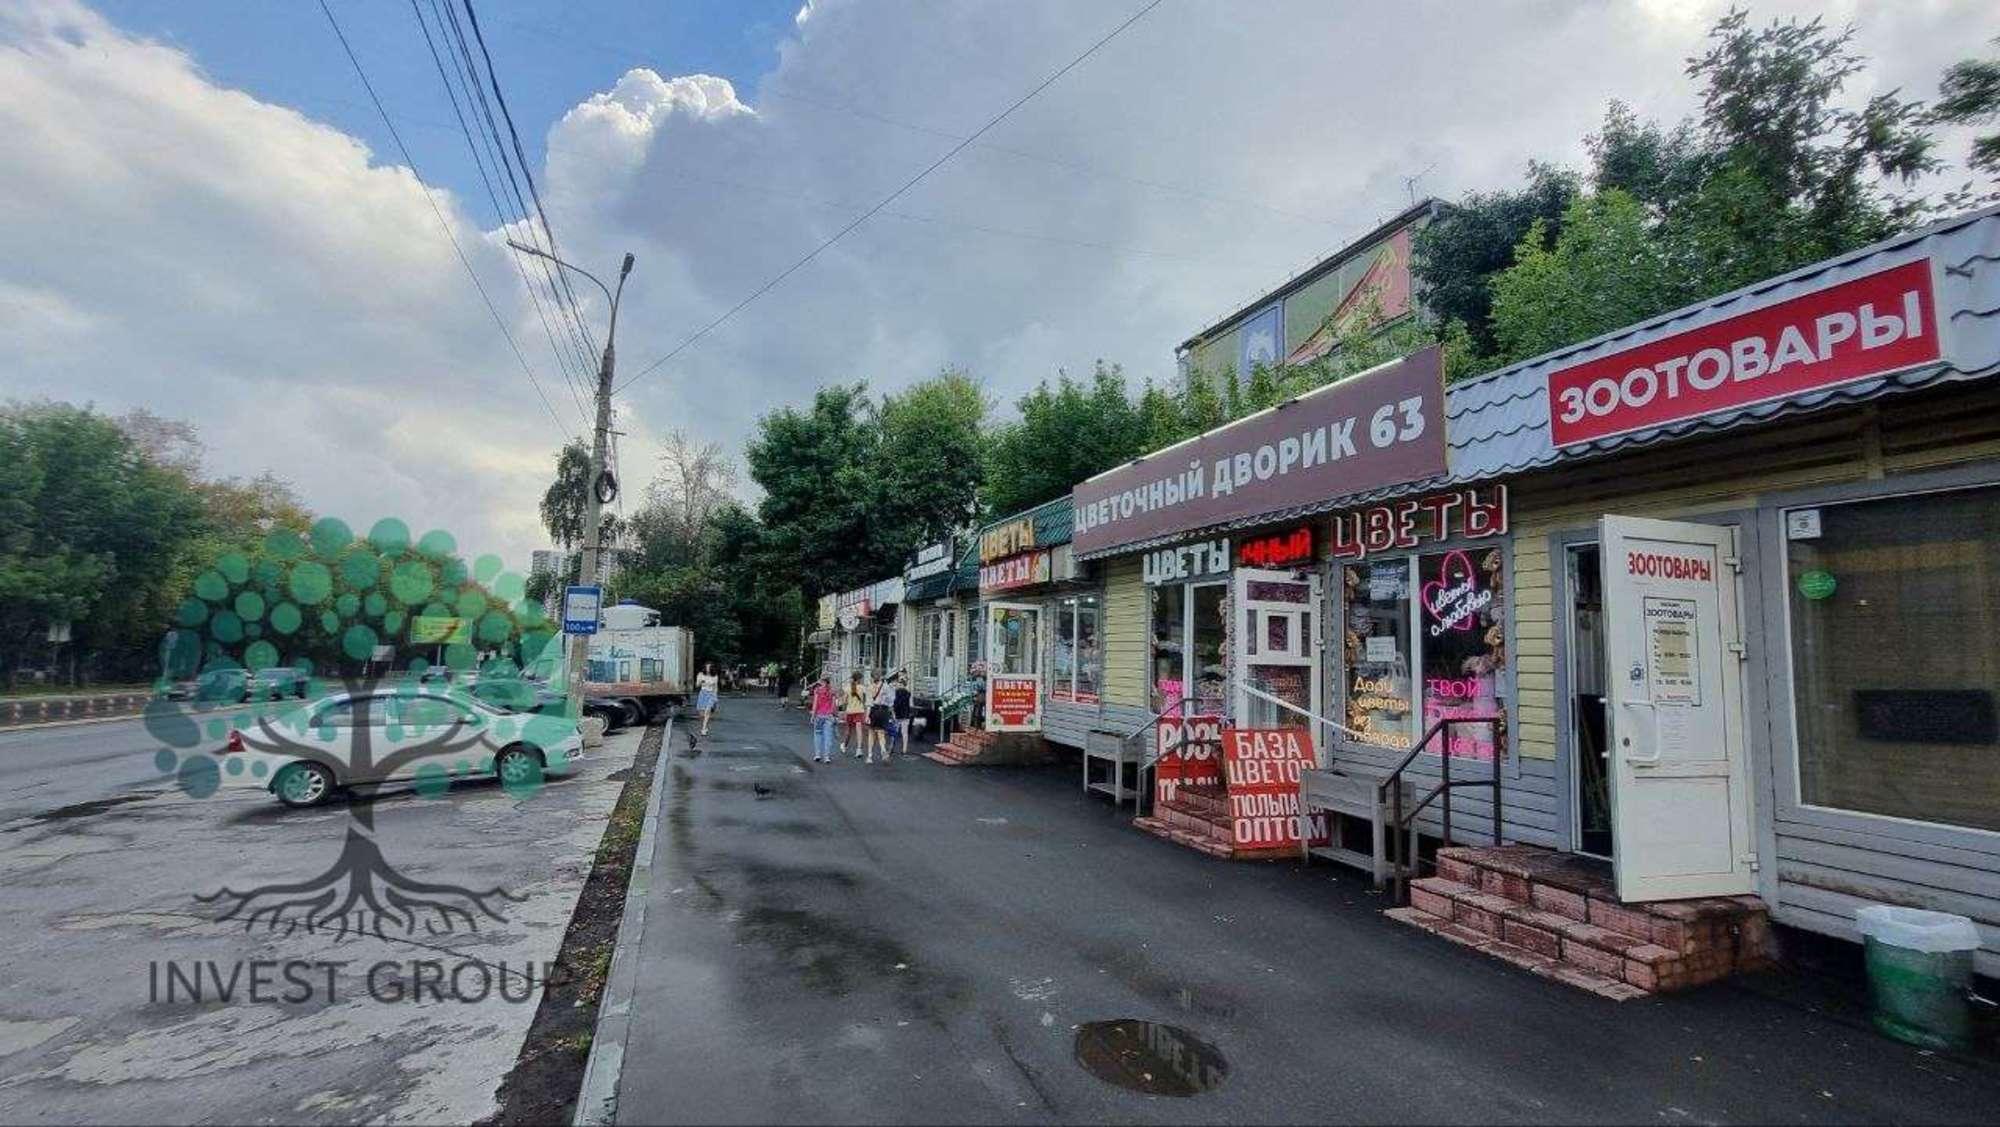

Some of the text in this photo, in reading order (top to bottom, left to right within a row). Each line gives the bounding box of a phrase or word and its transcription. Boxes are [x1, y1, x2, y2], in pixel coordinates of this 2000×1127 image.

[1558, 290, 1923, 424] ЗООТОВАРЫ
[1074, 396, 1426, 534] ЦВЕТОЧНЫЙ ДВОРИК 63
[1331, 484, 1508, 560] ЦВЕТЫ
[979, 556, 1032, 590] ЦВЕТЫ
[1143, 537, 1230, 585] ЦВЕТЫ
[1627, 551, 1712, 582] ЗООТОВАРЫ
[1427, 677, 1481, 698] ТВОЙ
[1236, 732, 1302, 759] БАЗА
[1231, 792, 1325, 817] ТЮЛЬПА
[1234, 816, 1328, 844] ОПТОМ
